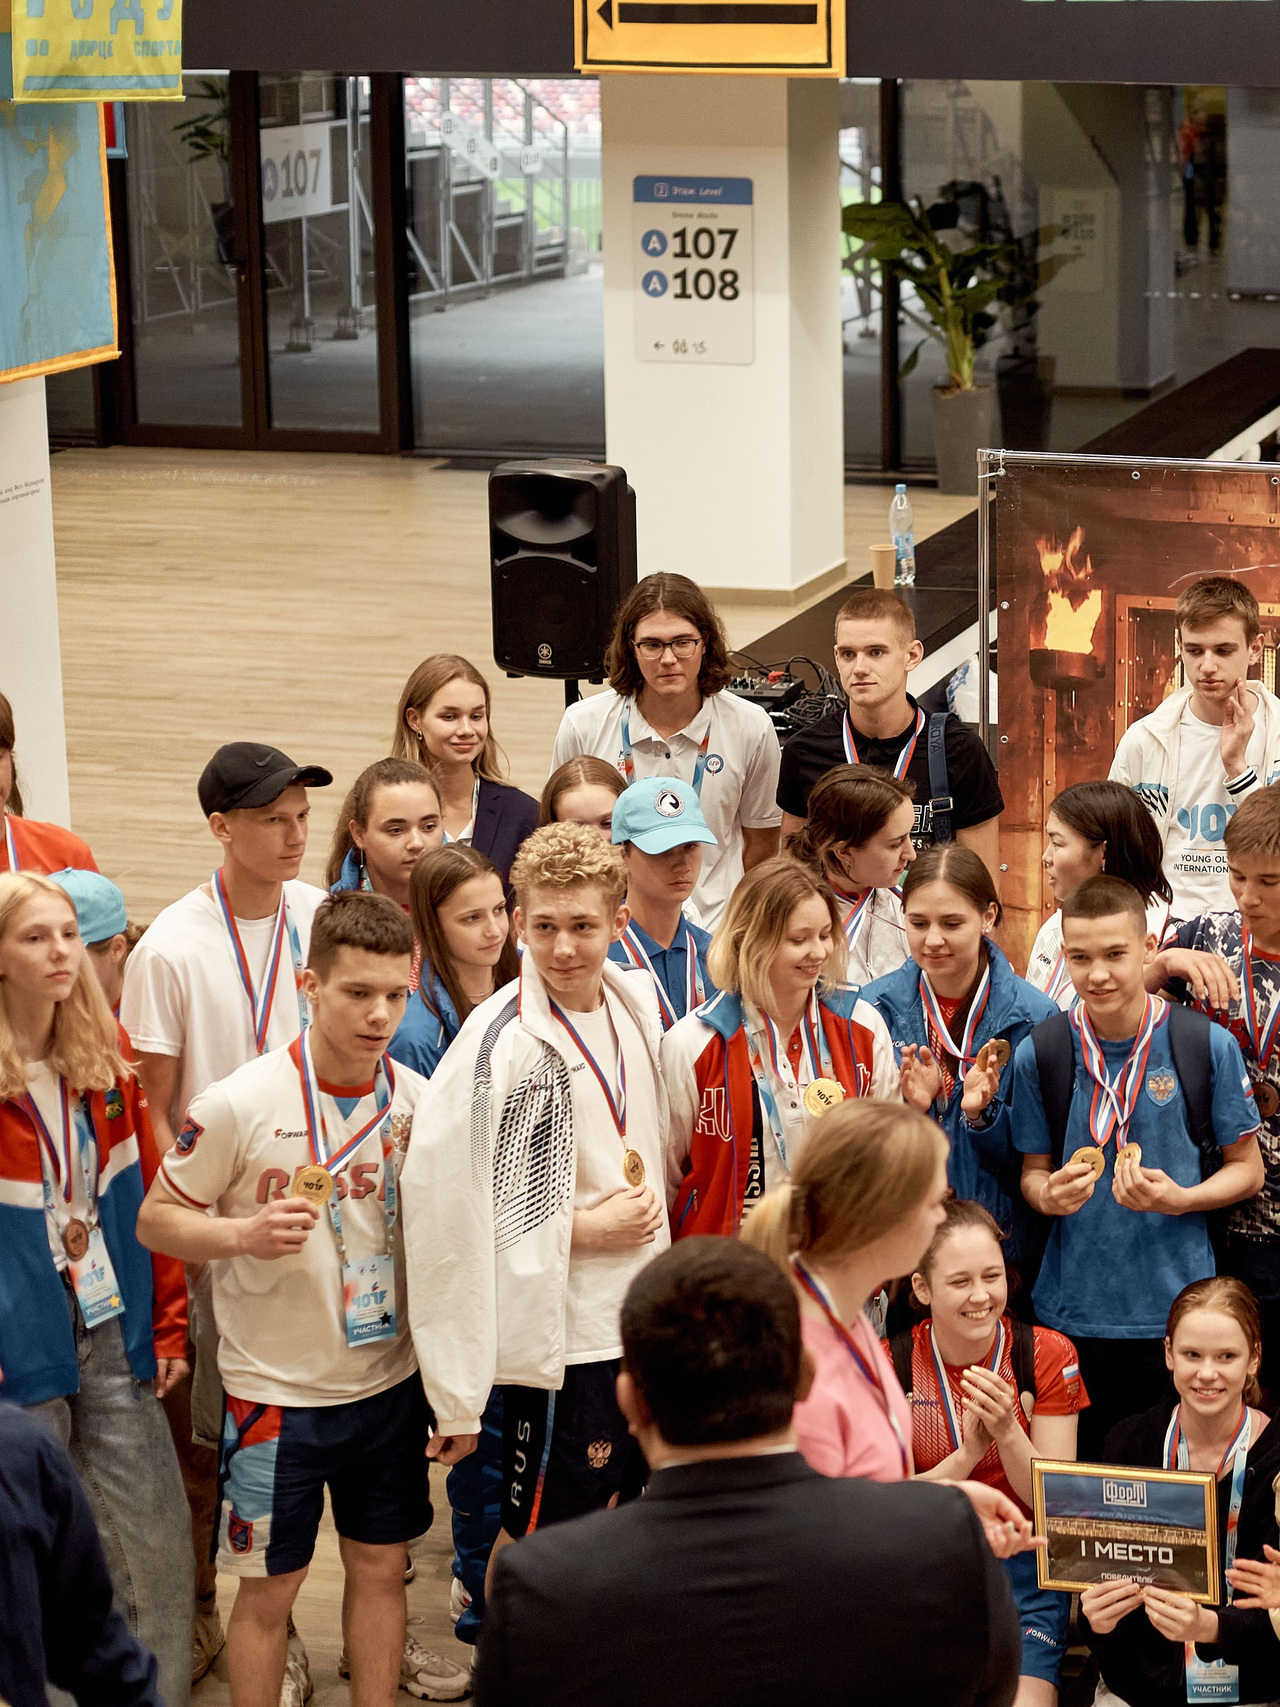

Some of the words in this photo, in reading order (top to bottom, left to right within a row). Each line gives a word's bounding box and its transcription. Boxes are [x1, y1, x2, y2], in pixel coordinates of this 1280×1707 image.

[134, 40, 181, 57] СПОРТА
[280, 148, 321, 197] 107
[672, 226, 738, 260] 107
[672, 267, 739, 301] 108
[1177, 804, 1238, 842] YO
[1181, 854, 1211, 863] YOUNG
[510, 1419, 531, 1507] RUS
[1094, 1541, 1174, 1564] МЕСТО
[1192, 1685, 1232, 1693] УЧАСТНИК
